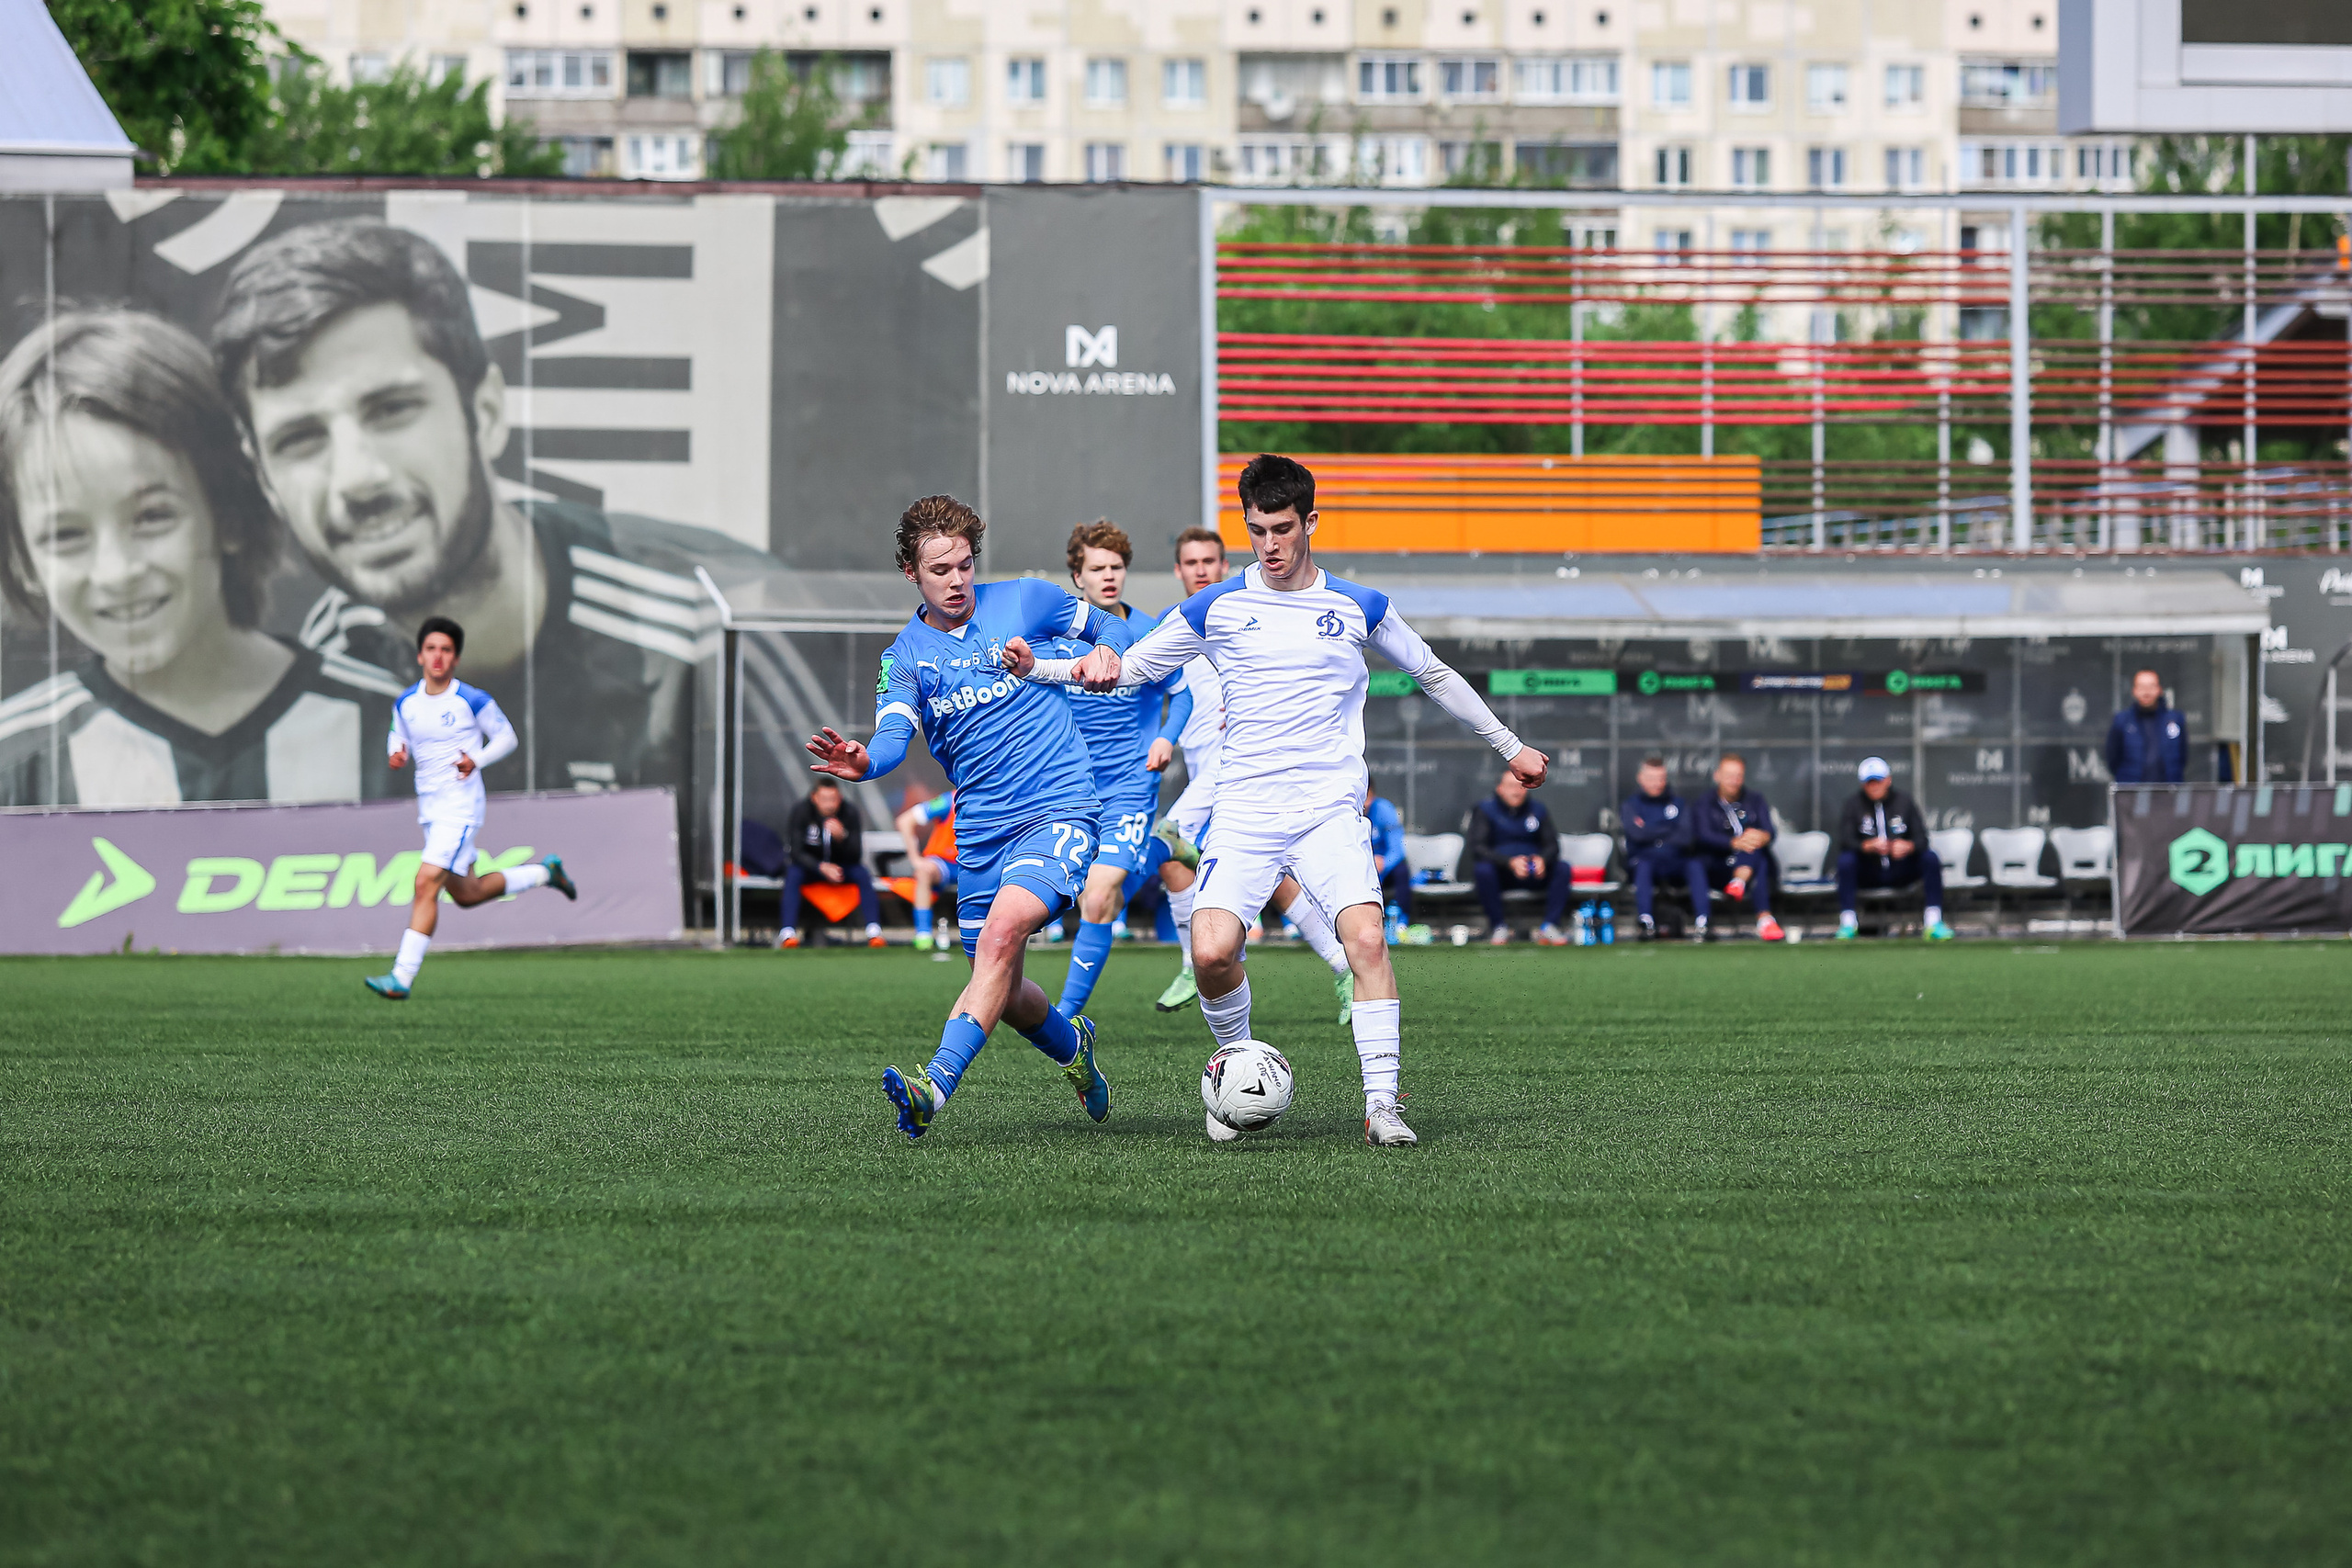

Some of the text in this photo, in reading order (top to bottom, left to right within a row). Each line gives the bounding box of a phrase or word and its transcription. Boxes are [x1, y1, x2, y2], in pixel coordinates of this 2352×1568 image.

[1007, 370, 1177, 396] NOVA ARENA
[1052, 822, 1089, 868] 72
[1114, 812, 1148, 845] 58
[1196, 858, 1218, 893] 7
[2183, 849, 2214, 874] 2
[176, 845, 536, 914] DEMX
